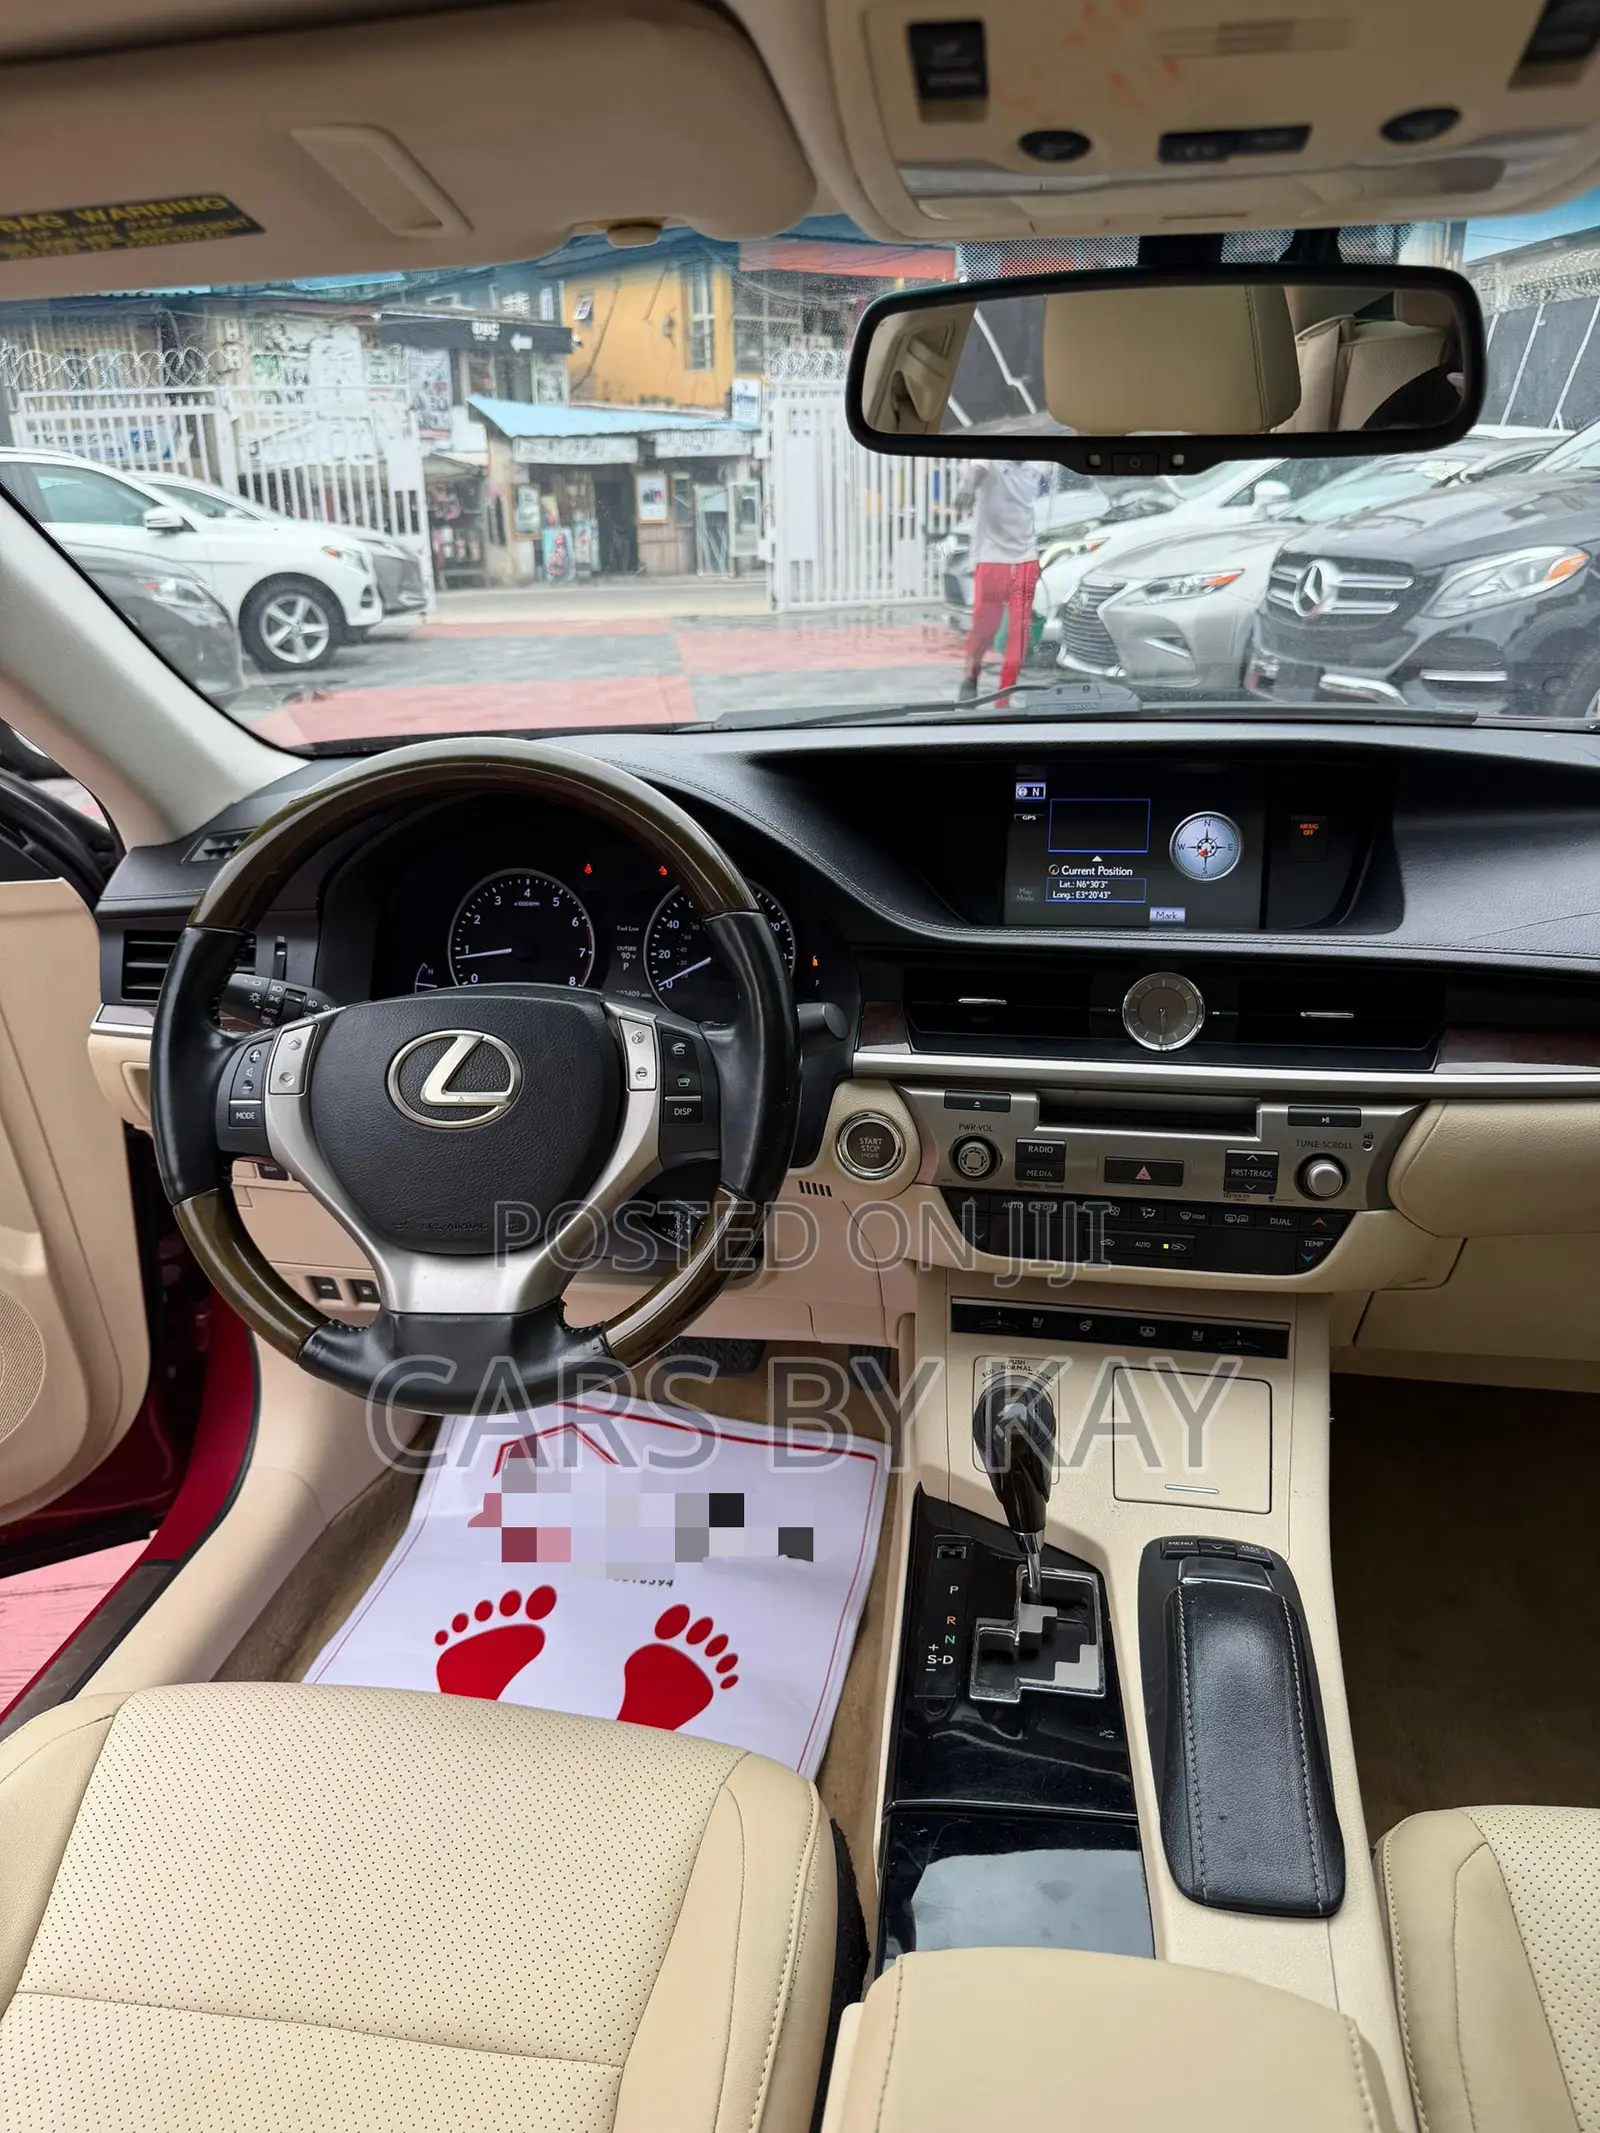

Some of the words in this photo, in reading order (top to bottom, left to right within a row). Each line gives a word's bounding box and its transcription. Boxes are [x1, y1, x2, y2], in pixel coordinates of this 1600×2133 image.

[74, 197, 229, 223] WARNING
[1032, 787, 1040, 796] N
[1061, 865, 1095, 876] Current
[1098, 865, 1133, 876] Position
[523, 888, 531, 897] 4
[494, 896, 502, 905] 3
[552, 897, 560, 907] 5
[473, 914, 481, 924] 2
[1155, 911, 1177, 920] Mark
[571, 917, 579, 927] 6
[666, 920, 680, 929] 40
[464, 945, 470, 954] 1
[579, 948, 586, 957] 7
[658, 949, 670, 959] 20
[623, 962, 629, 971] P
[470, 973, 479, 983] 0
[568, 976, 576, 986] 8
[235, 1111, 256, 1120] MODE
[674, 1108, 692, 1116] DISP
[859, 1137, 883, 1146] START
[860, 1144, 881, 1152] STOP
[1028, 1145, 1054, 1154] RADIO
[1026, 1169, 1053, 1177] MEDIA
[1001, 1201, 1024, 1210] AUTO
[1269, 1217, 1292, 1226] DUAL
[1304, 1239, 1324, 1248] TEMP
[1000, 1364, 1032, 1372] NORMAL
[981, 1368, 995, 1378] ECO
[949, 1585, 959, 1594] P
[946, 1615, 956, 1625] R
[944, 1635, 956, 1645] N
